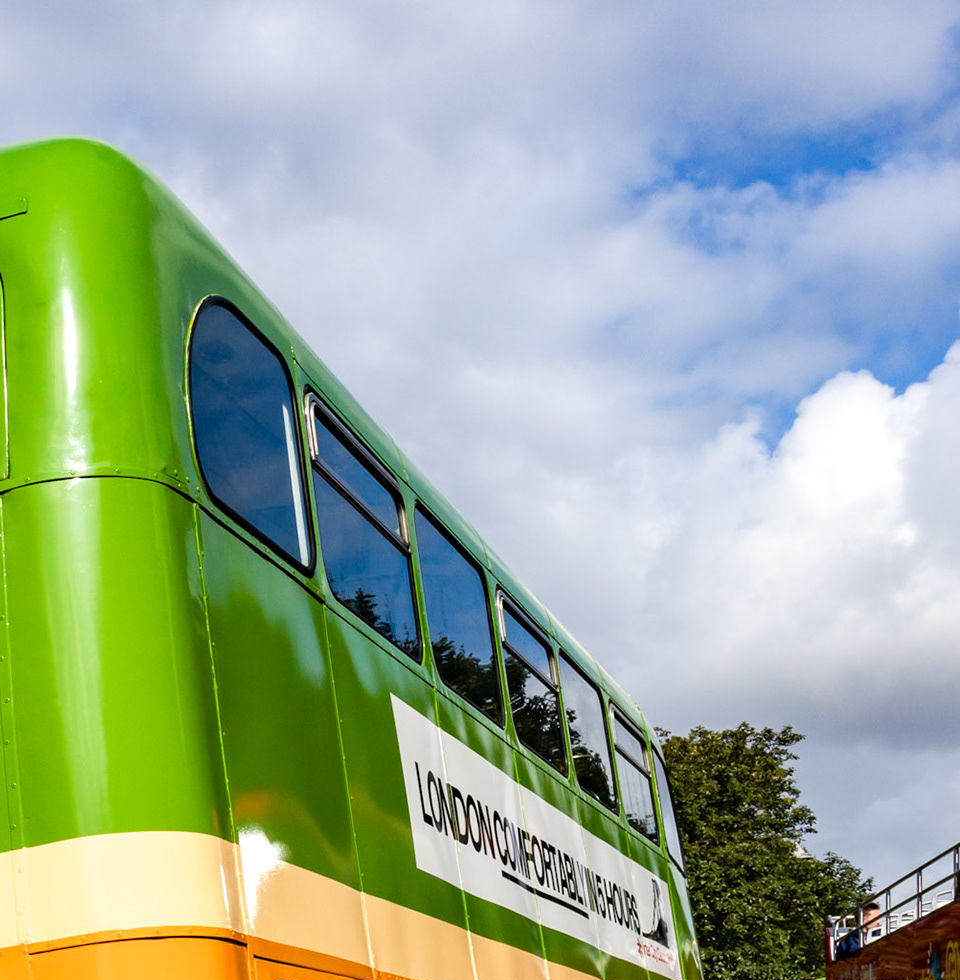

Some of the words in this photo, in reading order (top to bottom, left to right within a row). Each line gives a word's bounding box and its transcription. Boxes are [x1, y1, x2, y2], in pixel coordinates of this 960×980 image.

[415, 761, 496, 860] LONDON
[493, 810, 588, 907] COMFORTABLY
[596, 874, 606, 919] 5
[603, 878, 641, 936] HOURS
